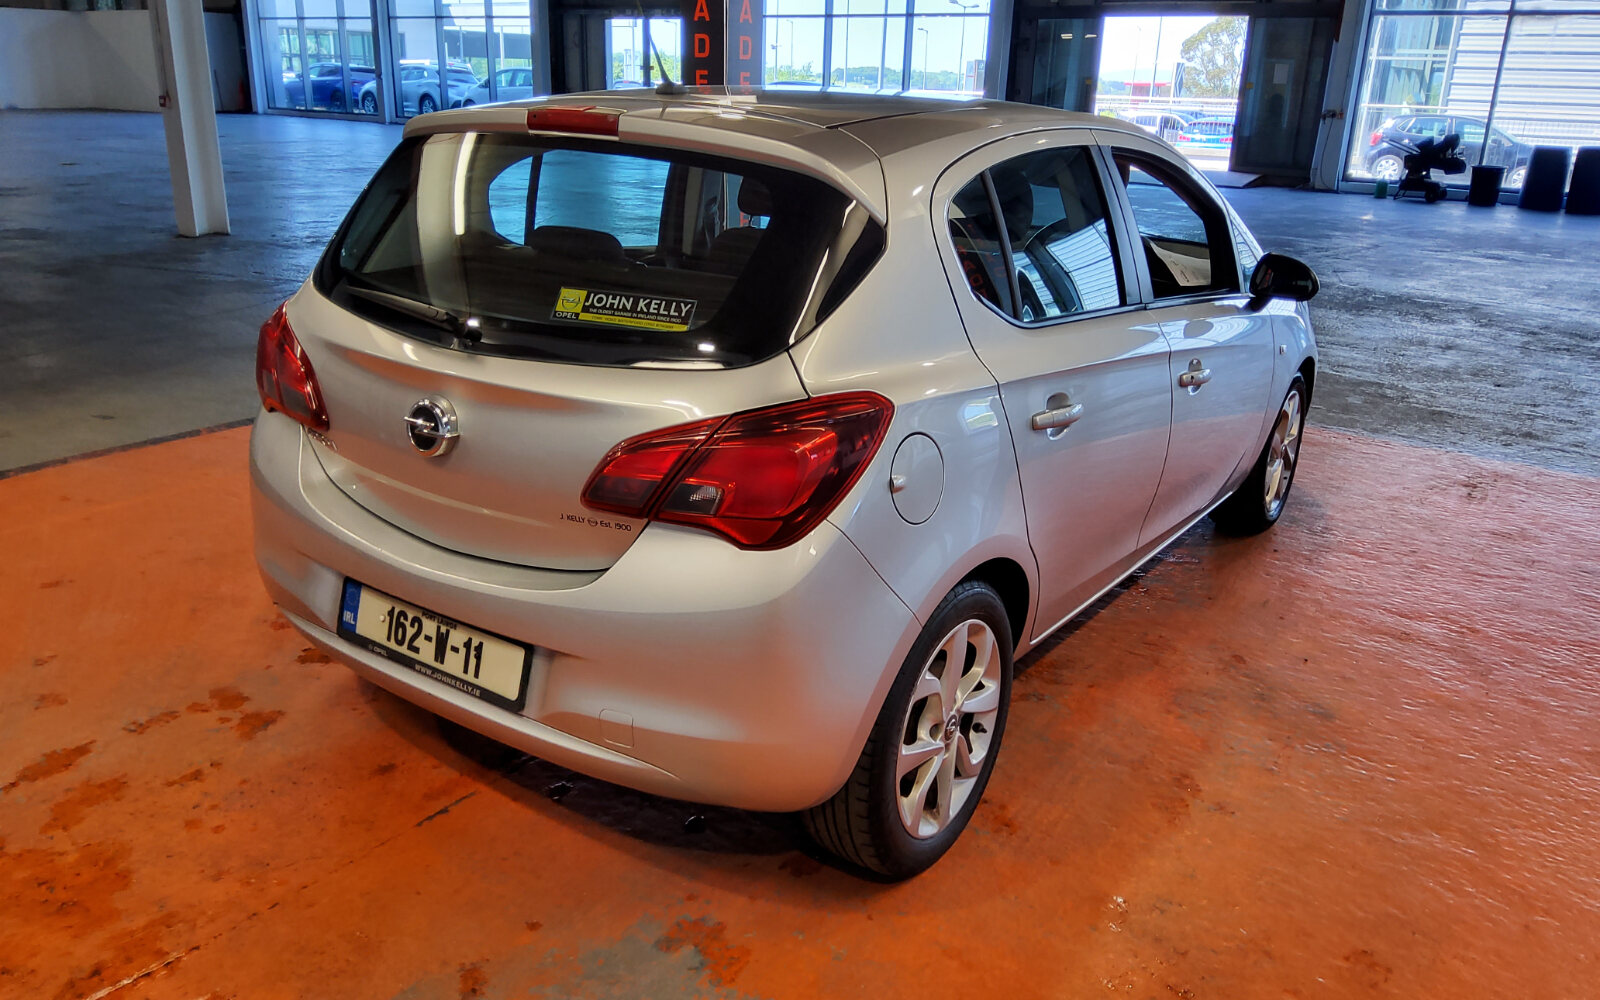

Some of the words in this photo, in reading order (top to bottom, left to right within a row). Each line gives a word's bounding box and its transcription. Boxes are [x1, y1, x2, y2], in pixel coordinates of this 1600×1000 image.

[585, 293, 634, 311] JOHN
[637, 297, 692, 317] KELLY
[555, 312, 577, 320] OPEL
[567, 514, 586, 524] KELLY
[614, 522, 632, 532] 1900
[343, 609, 355, 625] IRL
[373, 646, 388, 657] OPEL
[386, 606, 485, 680] 162-W-11
[414, 663, 481, 697] WWW.JOHNKELLY.IE
